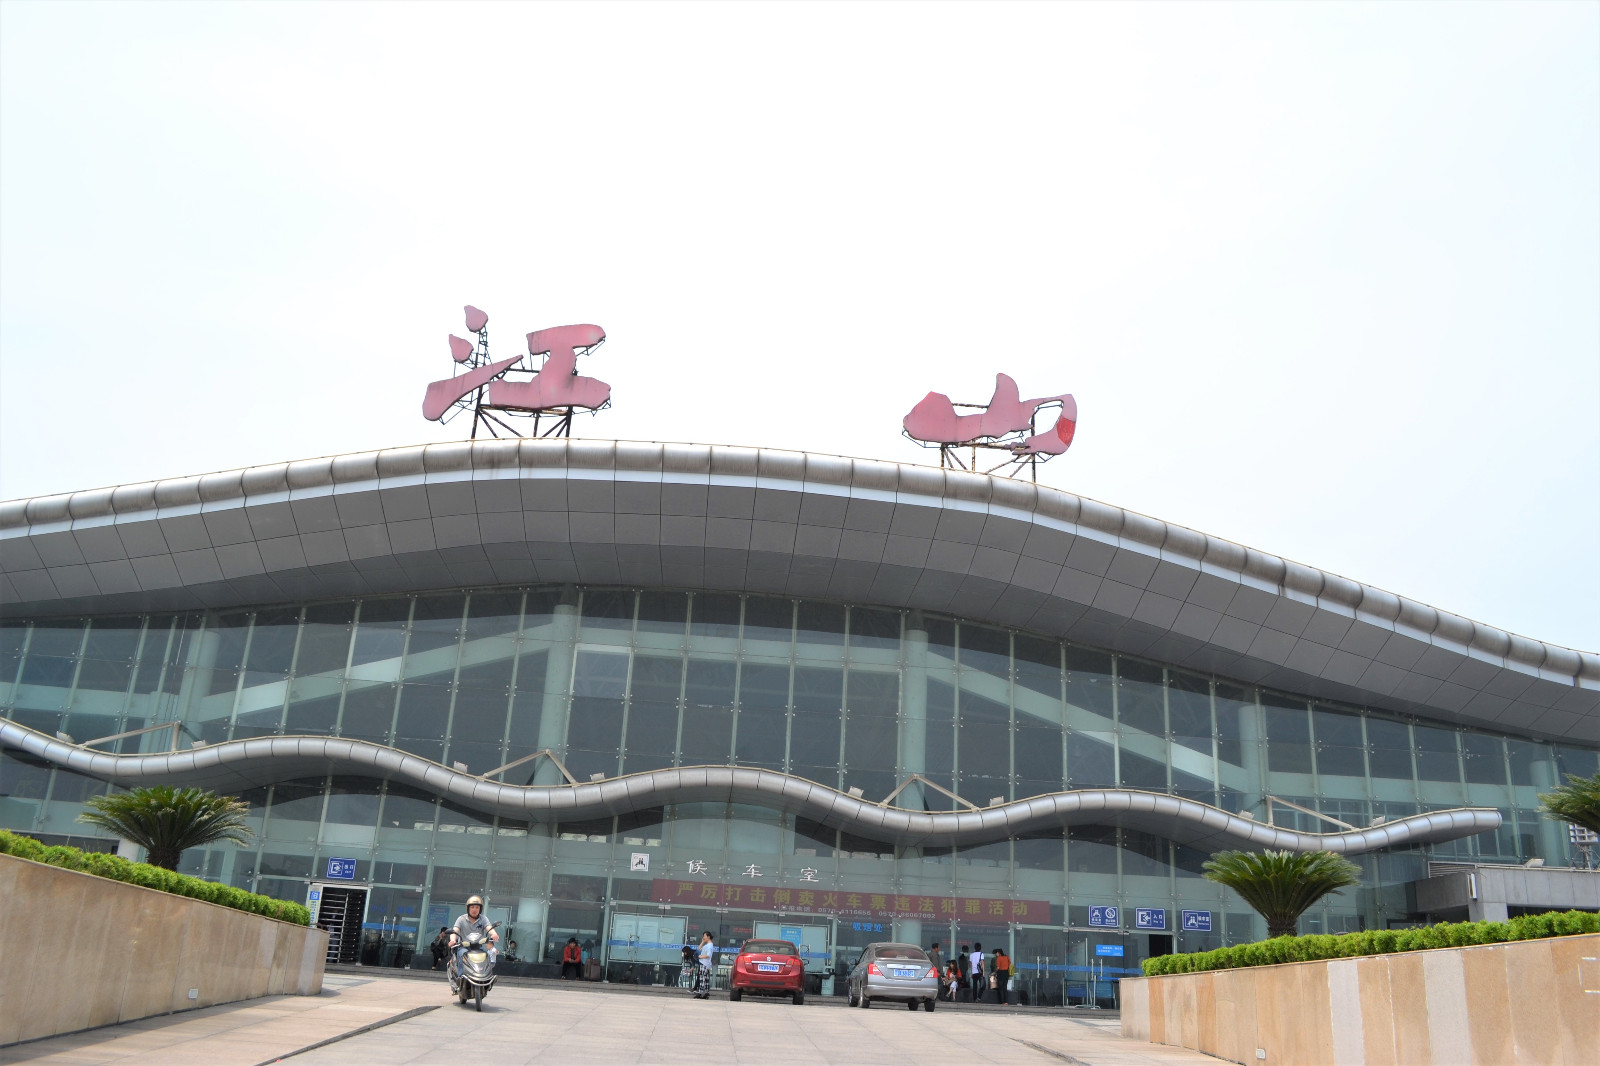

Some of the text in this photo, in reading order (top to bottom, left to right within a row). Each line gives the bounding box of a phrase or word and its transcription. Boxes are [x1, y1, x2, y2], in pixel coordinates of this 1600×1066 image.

[686, 859, 819, 882] 候车室
[676, 882, 1028, 917] 严厉打击倒卖火车票违法犯罪活动
